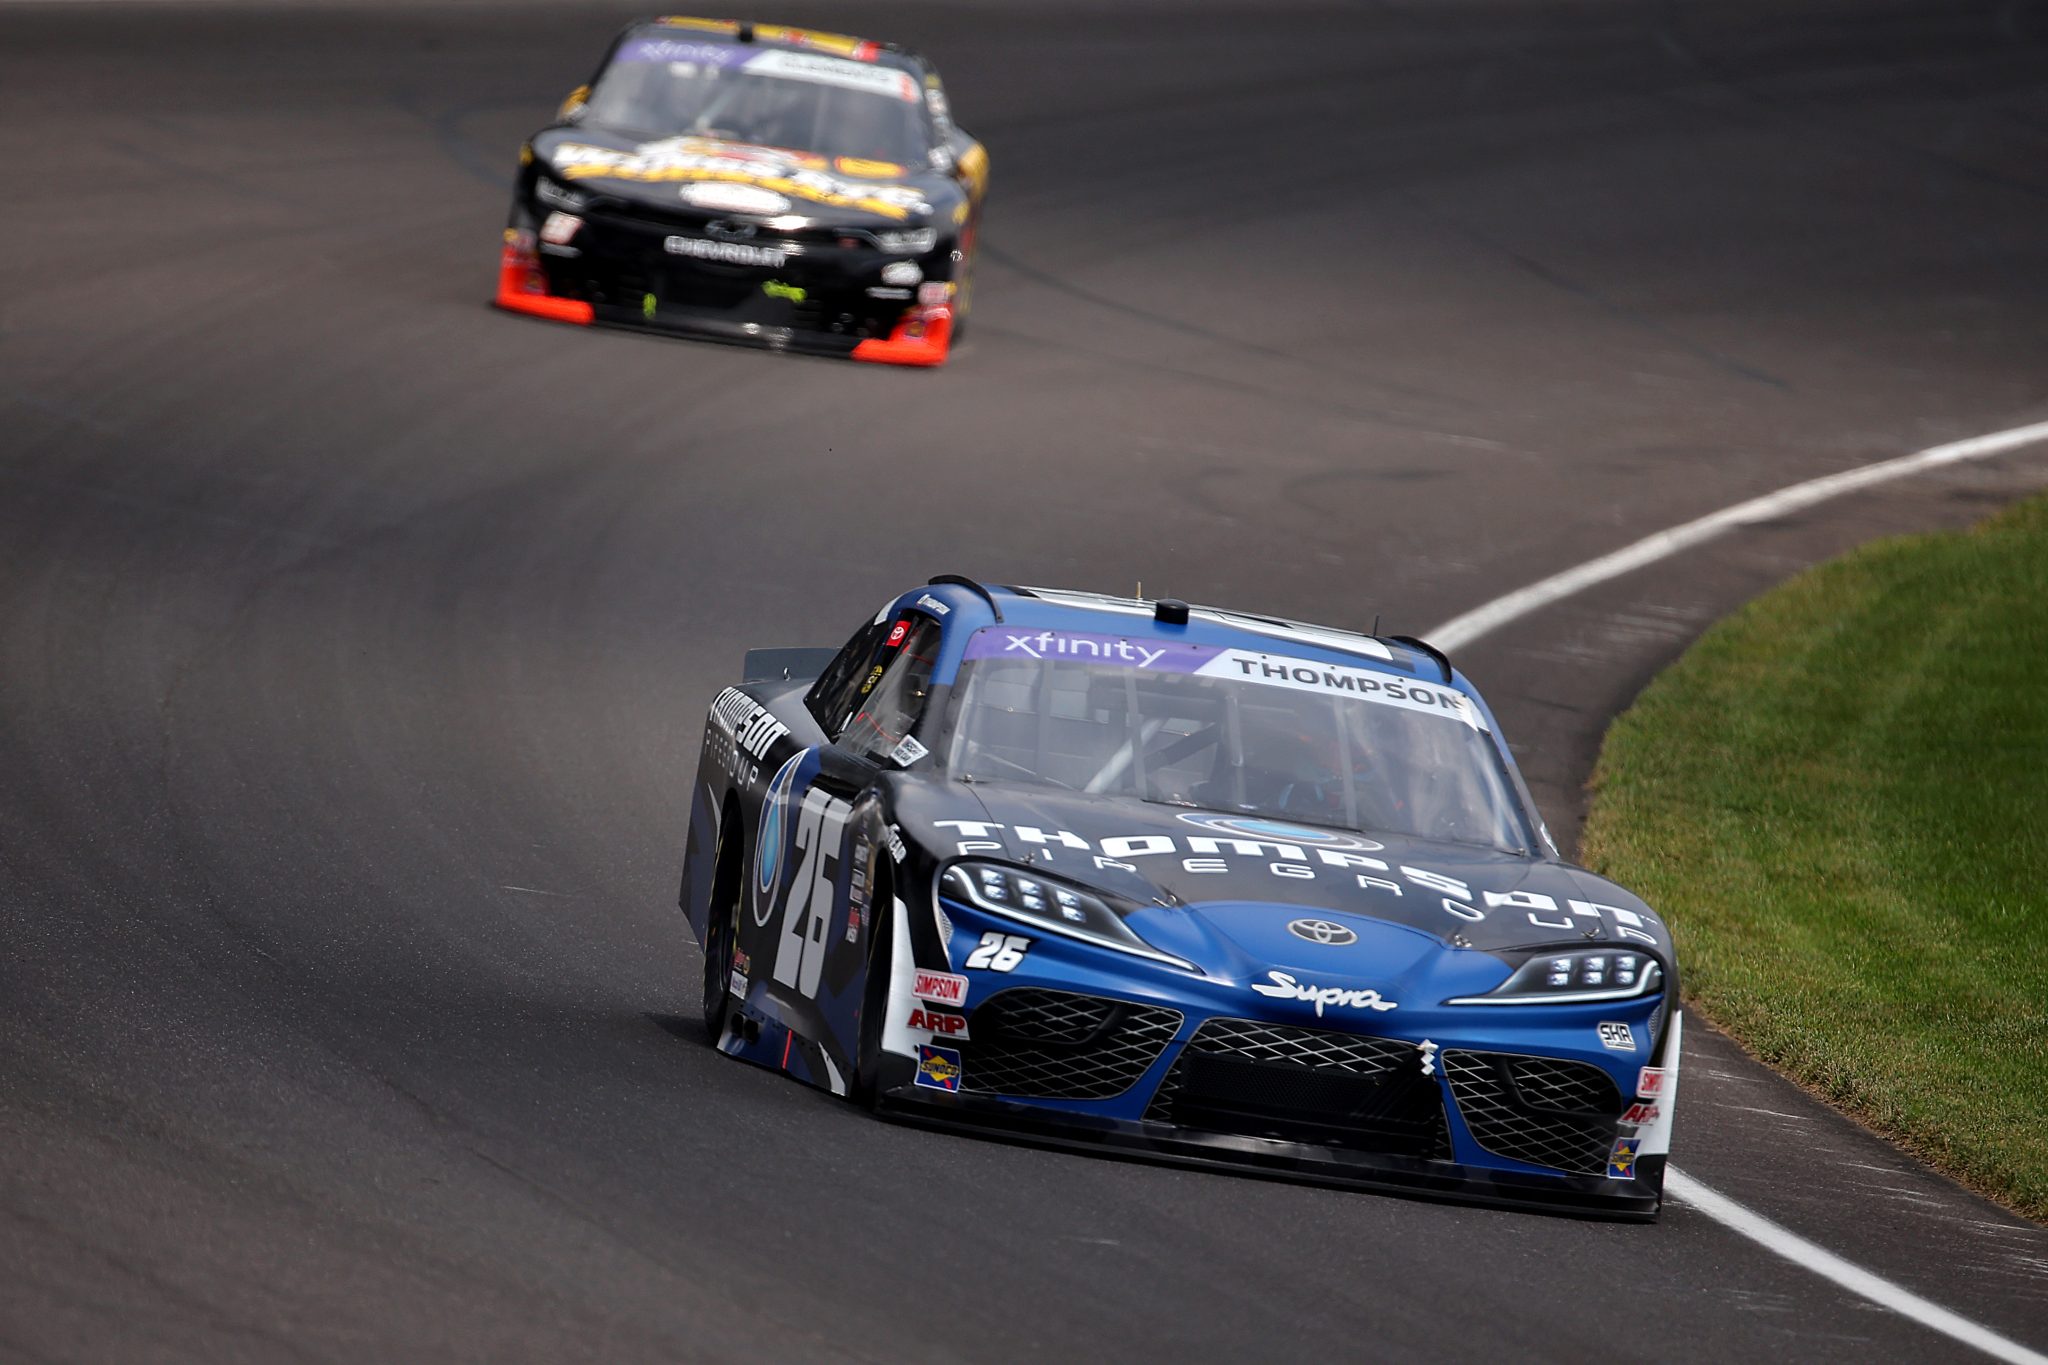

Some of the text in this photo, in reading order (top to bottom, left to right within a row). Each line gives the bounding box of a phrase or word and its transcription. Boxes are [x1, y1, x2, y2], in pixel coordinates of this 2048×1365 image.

[663, 235, 786, 269] CHEVROLET
[1005, 631, 1166, 668] xfinity
[1232, 657, 1463, 709] THOMPSON
[773, 786, 853, 1000] 26
[933, 820, 1644, 928] THOMPSON
[966, 932, 1029, 972] 26
[915, 975, 960, 999] SIMPSON
[1252, 971, 1398, 1017] Supra
[908, 1009, 966, 1034] ARP
[921, 1061, 959, 1076] SUNOCO
